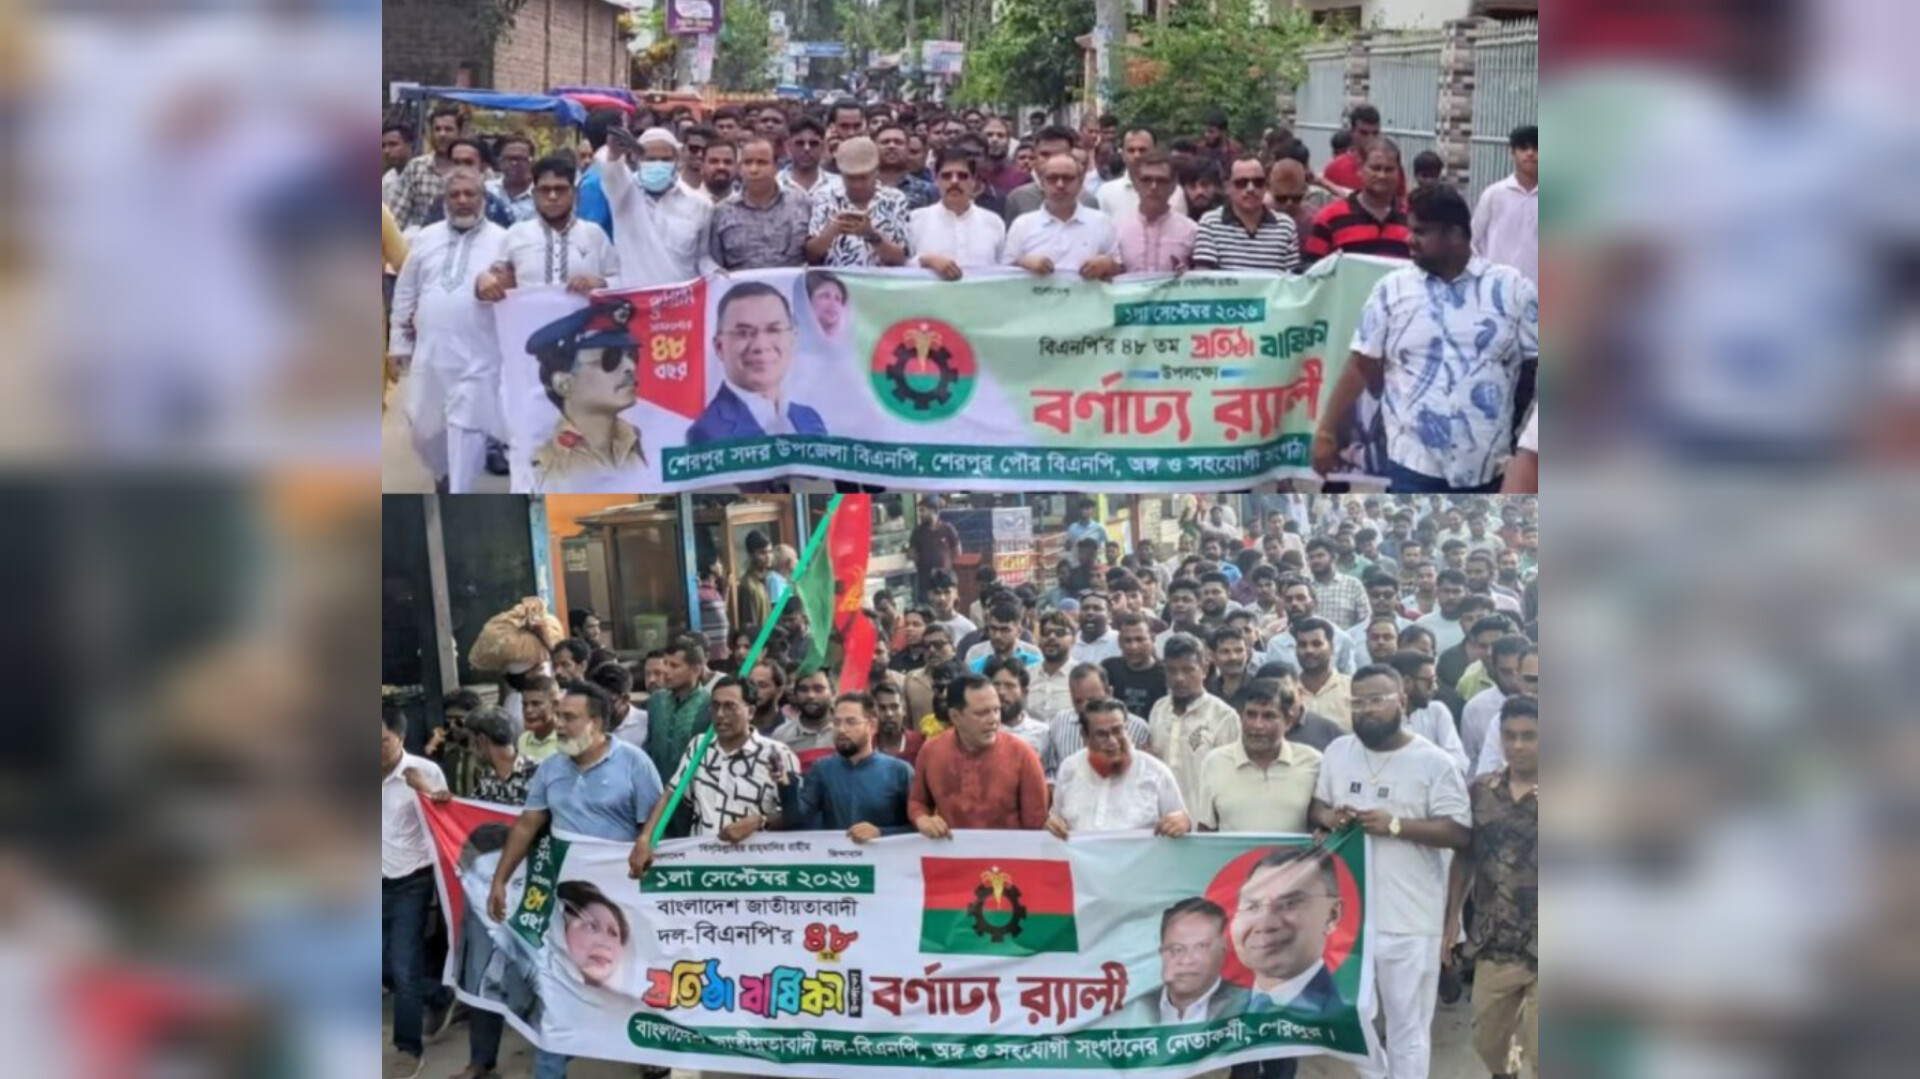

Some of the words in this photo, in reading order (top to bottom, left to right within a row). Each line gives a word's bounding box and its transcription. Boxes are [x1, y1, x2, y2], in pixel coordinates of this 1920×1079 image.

[1152, 303, 1211, 321] সেপ্টেম্বর
[1215, 303, 1258, 319] ২০২৬
[651, 334, 687, 361] ৪৮
[1121, 338, 1148, 355] ৪৮
[1153, 337, 1180, 354] তম
[1029, 370, 1192, 442] বর্ণাঢ্য
[668, 449, 724, 475] শেরপুর
[730, 443, 771, 465] সদর
[775, 438, 848, 464] উপজেলা
[854, 445, 924, 473] বিএনপি,
[931, 452, 994, 476] শেরপুর
[1000, 451, 1042, 473] পৌর
[1046, 451, 1121, 477] বিএনপি,
[1127, 455, 1162, 474] অঙ্গ
[1166, 457, 1182, 472] ও
[1188, 448, 1260, 475] সহযোগী
[656, 869, 693, 887] ১লা
[701, 867, 789, 887] সেপ্টেম্বর
[797, 870, 861, 888] ২০২৬
[656, 898, 739, 916] বাংলাদেশ
[746, 896, 859, 916] জাতীয়তাবাদী
[802, 922, 859, 953] ৪৮
[869, 962, 1001, 1024] বর্ণাঢ্য
[1016, 961, 1129, 1026] র‍্যালী
[932, 1041, 966, 1060] অঙ্গ
[973, 1043, 988, 1059] ও
[994, 1036, 1070, 1062] সহযোগী
[1075, 1031, 1158, 1059] সংগঠনের
[1166, 1018, 1251, 1055] নেতাকর্মী,
